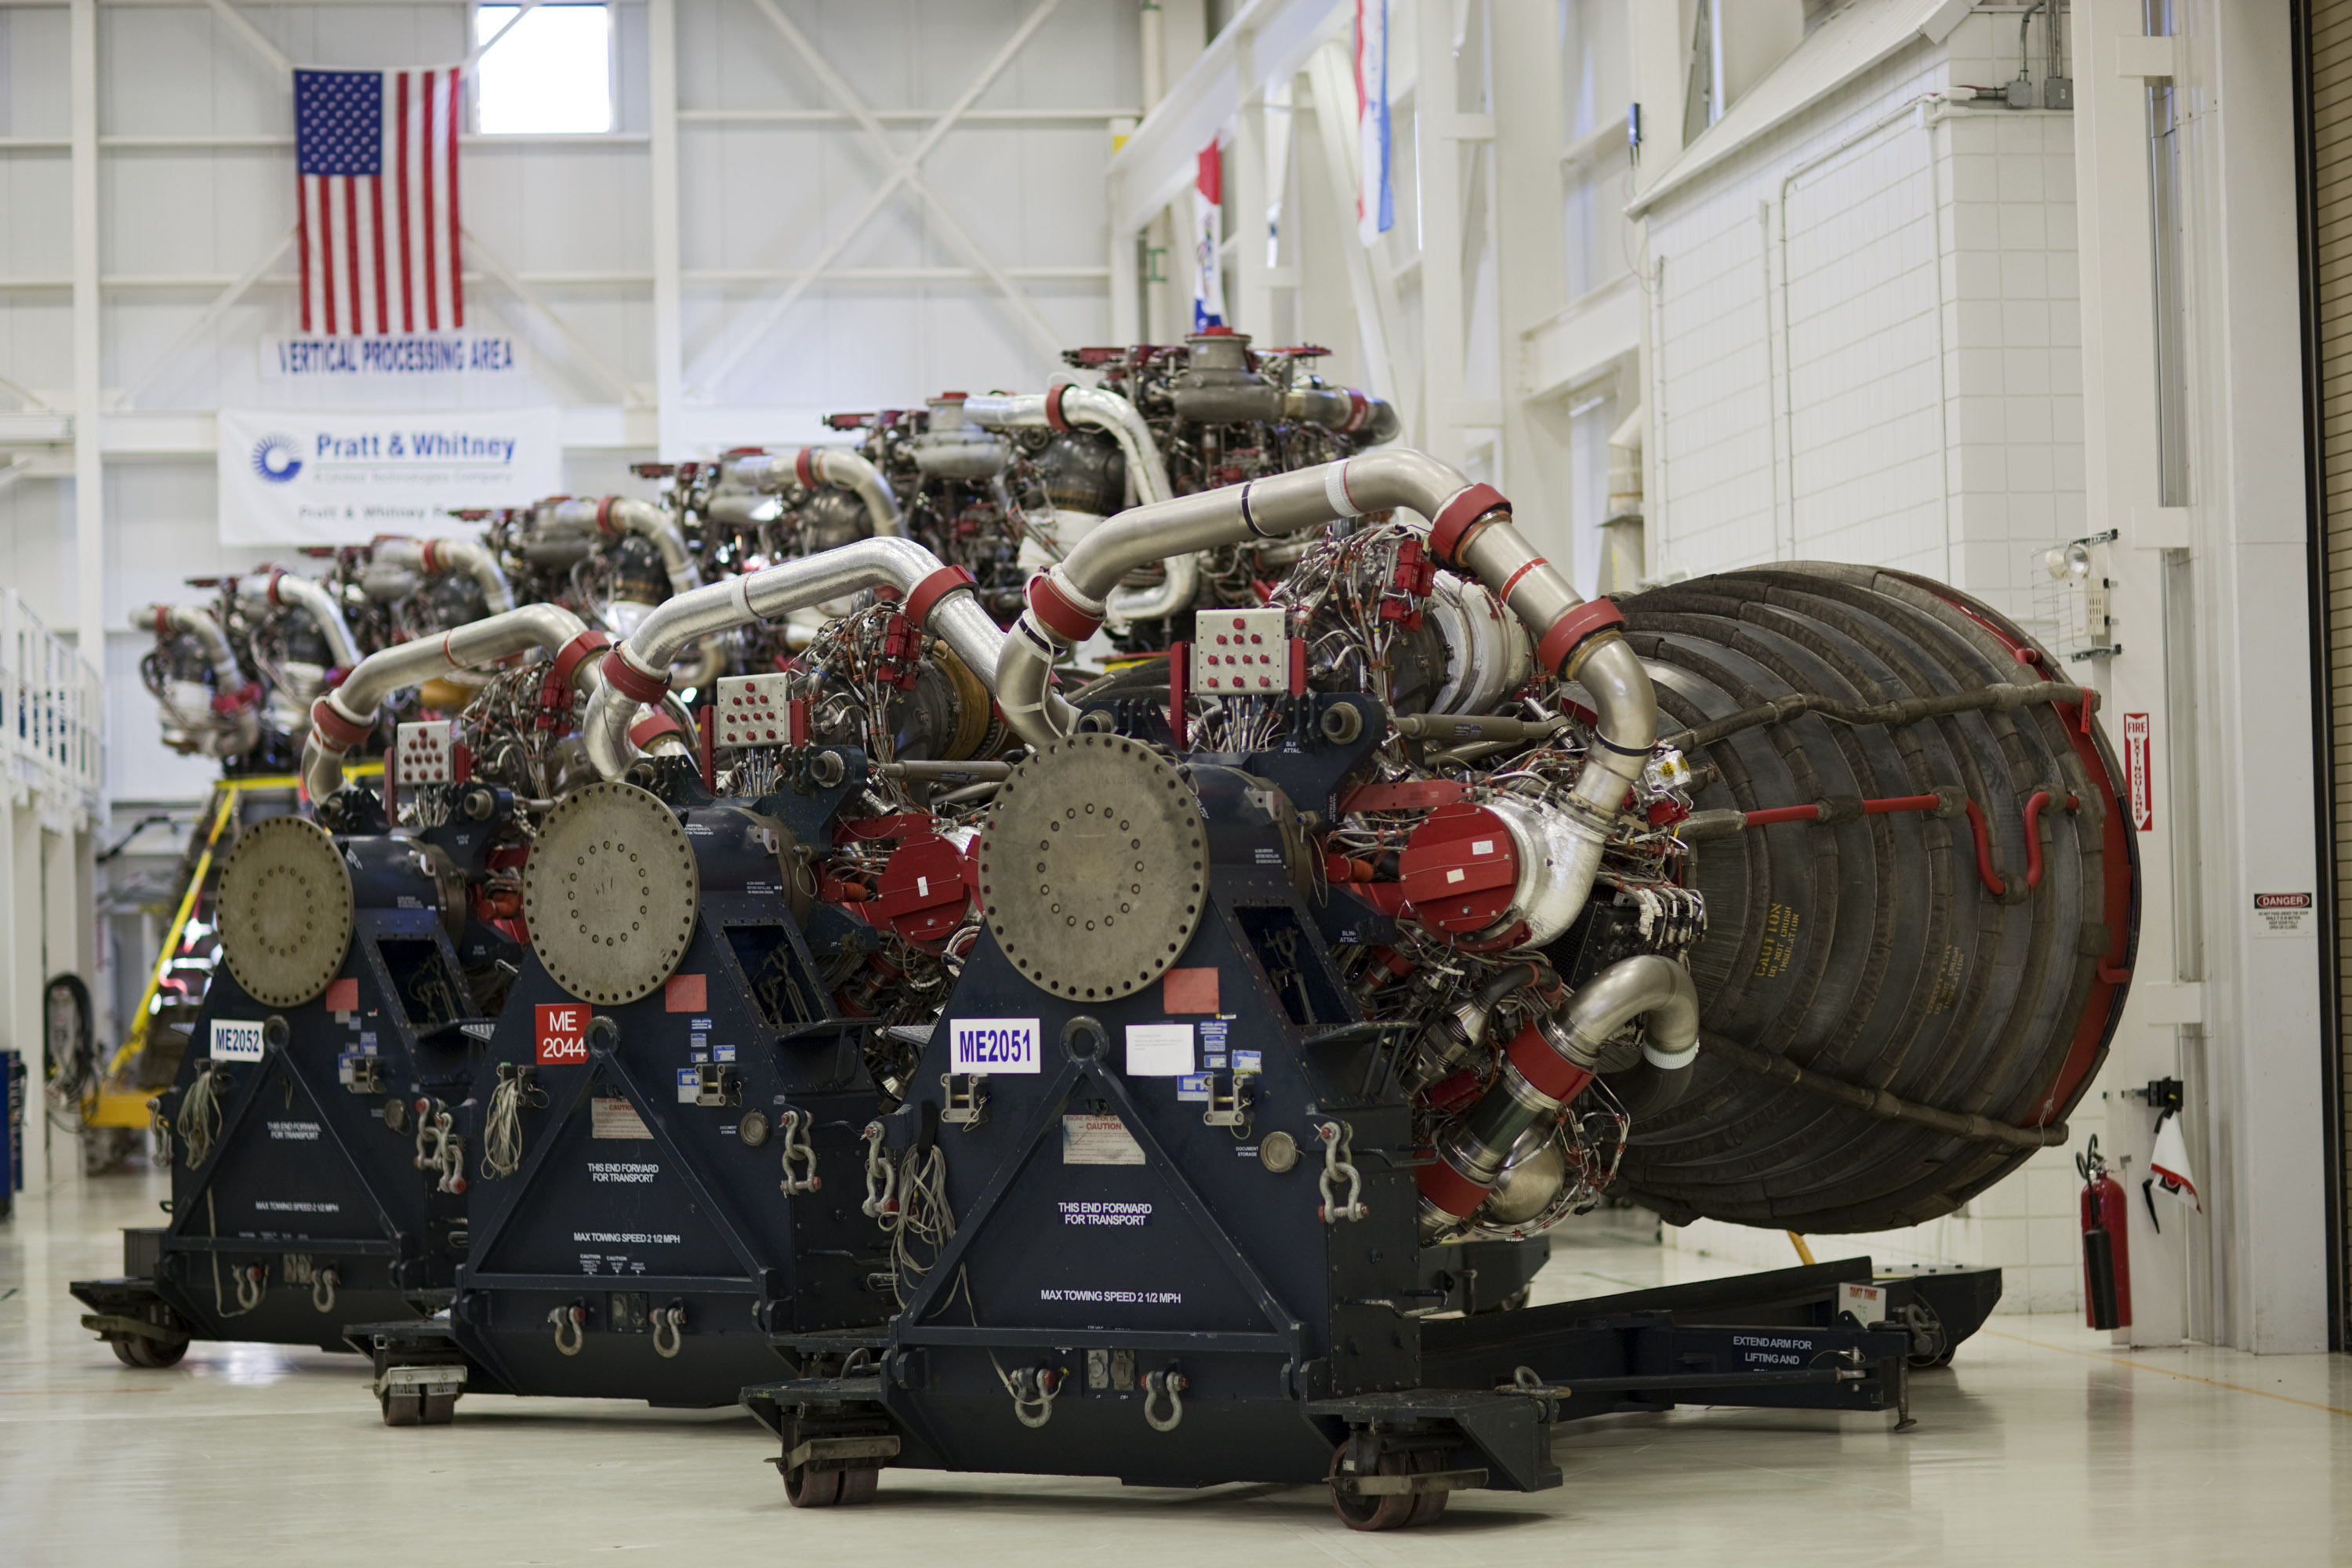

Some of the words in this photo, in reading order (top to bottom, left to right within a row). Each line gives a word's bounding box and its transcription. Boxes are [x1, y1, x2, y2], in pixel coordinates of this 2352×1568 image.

[278, 341, 357, 372] VERTICAL
[363, 340, 463, 372] PROCESSING
[472, 340, 513, 371] AREA
[317, 434, 379, 457] Pratt
[389, 434, 405, 456] &
[412, 434, 515, 464] Whitney
[2127, 721, 2146, 733] FIRE
[2134, 737, 2143, 821] EXTINGUISHER
[2263, 896, 2303, 906] DANGER
[1755, 902, 1782, 977] CAUTION
[1768, 965, 1777, 978] DO
[1773, 942, 1784, 960] NOT
[1780, 906, 1792, 938] CRUSH
[1779, 913, 1799, 971] INSULATION
[549, 1011, 577, 1032] ME
[216, 1028, 260, 1052] ME2052
[543, 1036, 586, 1058] 2044
[960, 1029, 1031, 1062] ME2051
[285, 1131, 320, 1140] TRANSPORT
[587, 1163, 604, 1172] THIS
[605, 1163, 621, 1172] END
[622, 1163, 659, 1174] FORWARD
[593, 1173, 609, 1182] FOR
[609, 1174, 654, 1182] TRANSPORT
[1058, 1202, 1080, 1213] THIS
[1081, 1203, 1102, 1213] END
[1102, 1203, 1152, 1214] FORWARD
[1065, 1214, 1086, 1225] FOR
[1087, 1214, 1145, 1225] TRANSPORT
[573, 1232, 591, 1242] MAX
[591, 1232, 621, 1243] TOWING
[622, 1233, 646, 1243] SPEED
[647, 1234, 652, 1243] 2
[653, 1234, 662, 1243] 1/2
[663, 1234, 681, 1243] MPH
[1040, 1290, 1062, 1301] MAX
[1064, 1290, 1102, 1301] TOWING
[1104, 1291, 1136, 1302] SPEED
[1138, 1292, 1144, 1302] 2
[1145, 1292, 1158, 1302] 1/2
[1160, 1293, 1181, 1303] MPH
[1864, 1288, 1878, 1301] TIME
[1733, 1335, 1770, 1347] EXTEND
[1770, 1338, 1791, 1348] ARM
[1792, 1339, 1812, 1350] FOR
[1744, 1352, 1780, 1363] LIFTING
[1780, 1354, 1800, 1365] AND
